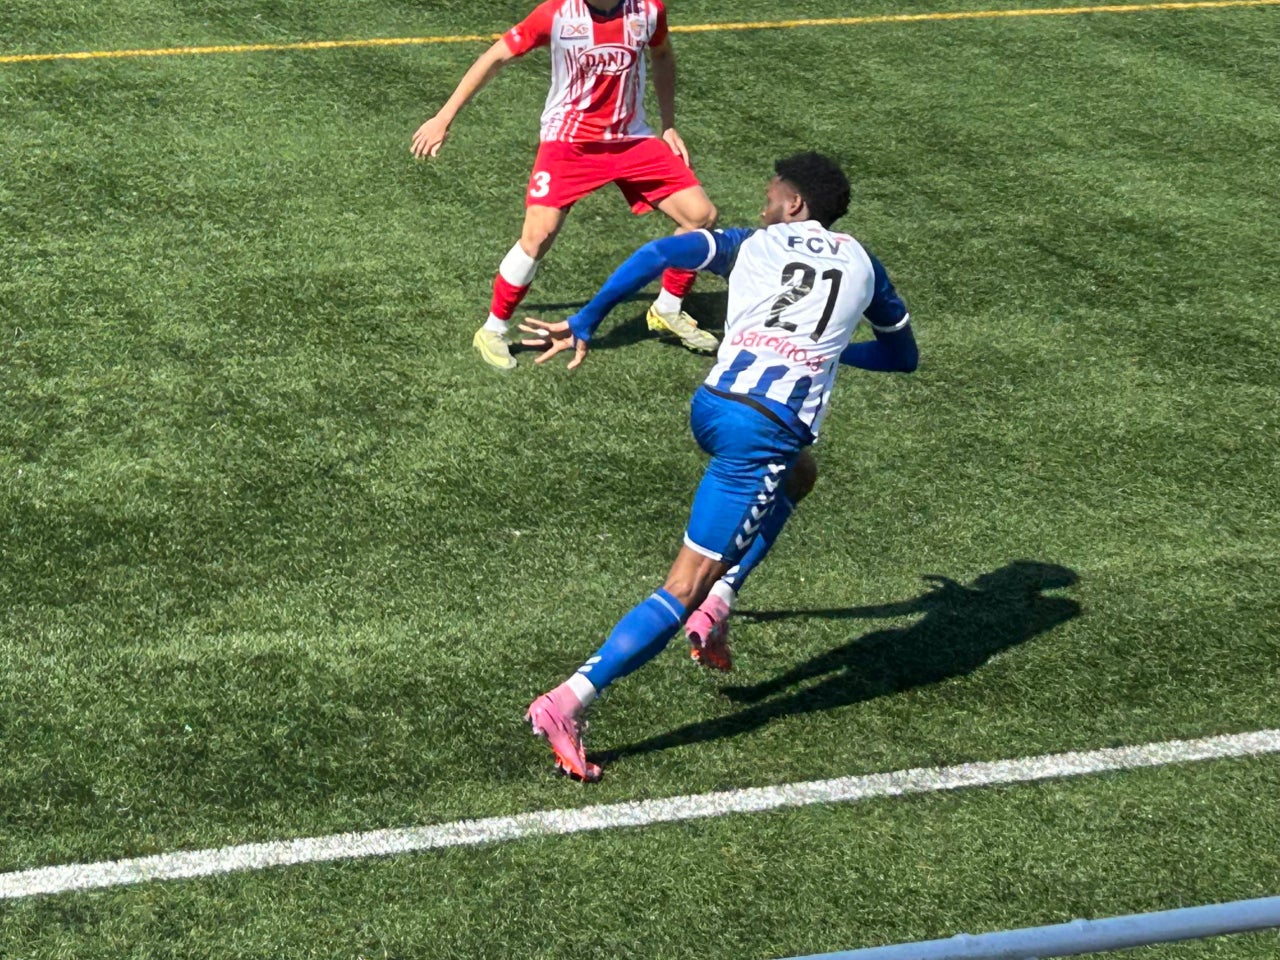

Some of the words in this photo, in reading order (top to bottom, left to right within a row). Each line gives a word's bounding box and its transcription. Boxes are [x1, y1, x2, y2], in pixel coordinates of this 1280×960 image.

[585, 51, 626, 68] DANI
[530, 171, 551, 198] 3
[787, 235, 841, 256] FCV
[763, 261, 843, 344] 21
